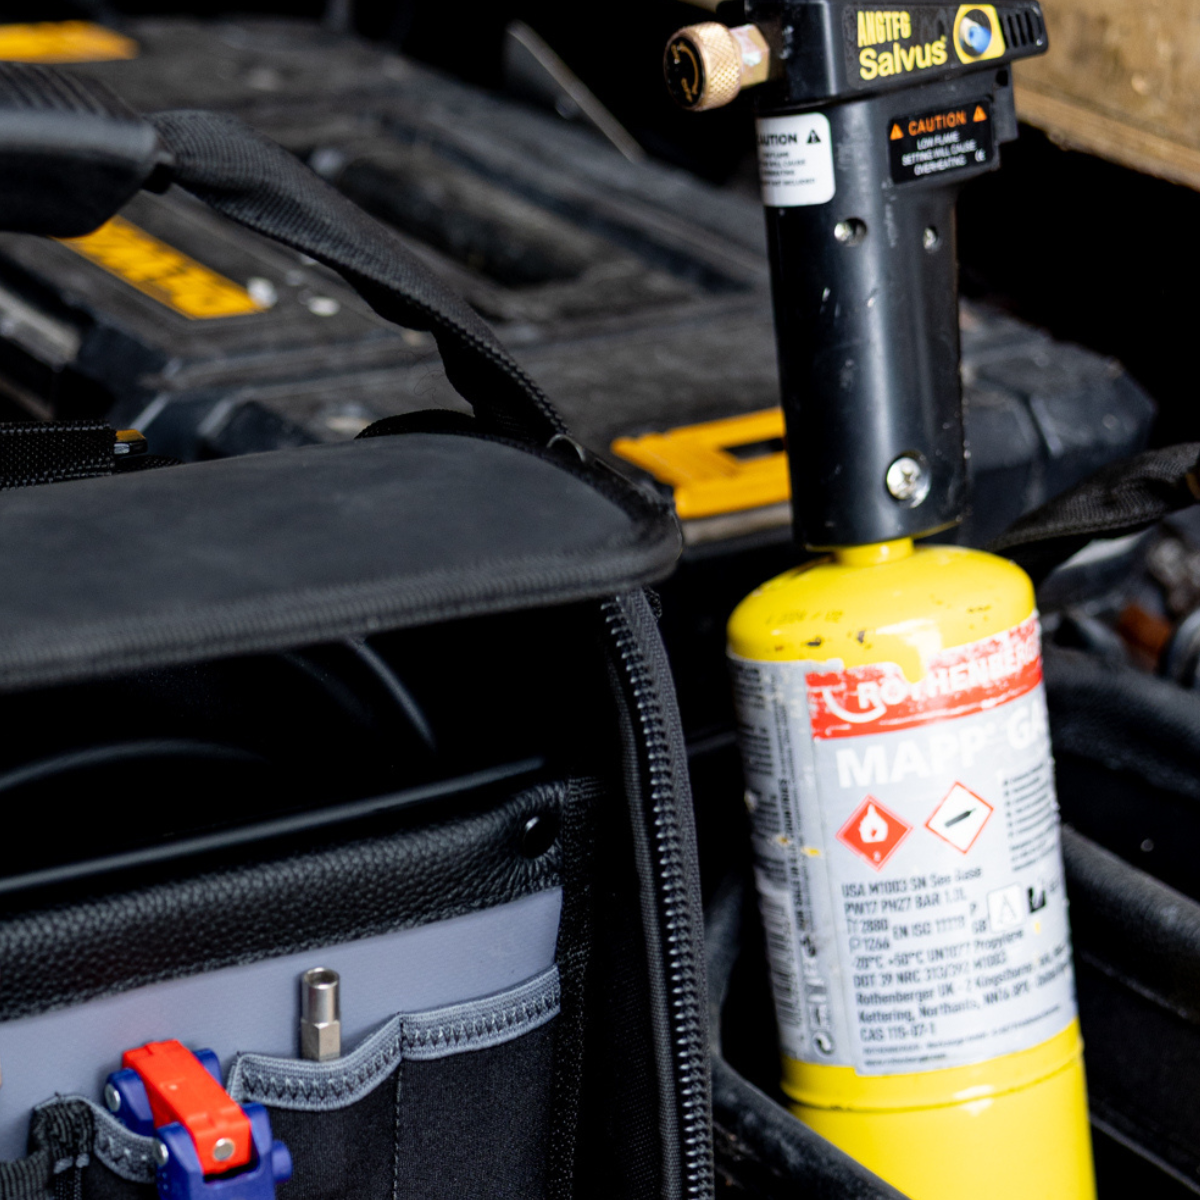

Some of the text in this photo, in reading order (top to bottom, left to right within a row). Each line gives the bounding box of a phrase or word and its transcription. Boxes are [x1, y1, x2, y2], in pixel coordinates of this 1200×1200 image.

[859, 42, 948, 80] Salvus
[908, 110, 967, 137] CAUTION
[836, 725, 988, 789] MAPP
[841, 882, 866, 898] USA
[915, 893, 940, 909] BAR
[853, 973, 875, 988] DOT
[856, 989, 934, 1006] Rothenberger
[860, 1027, 884, 1041] CAS
